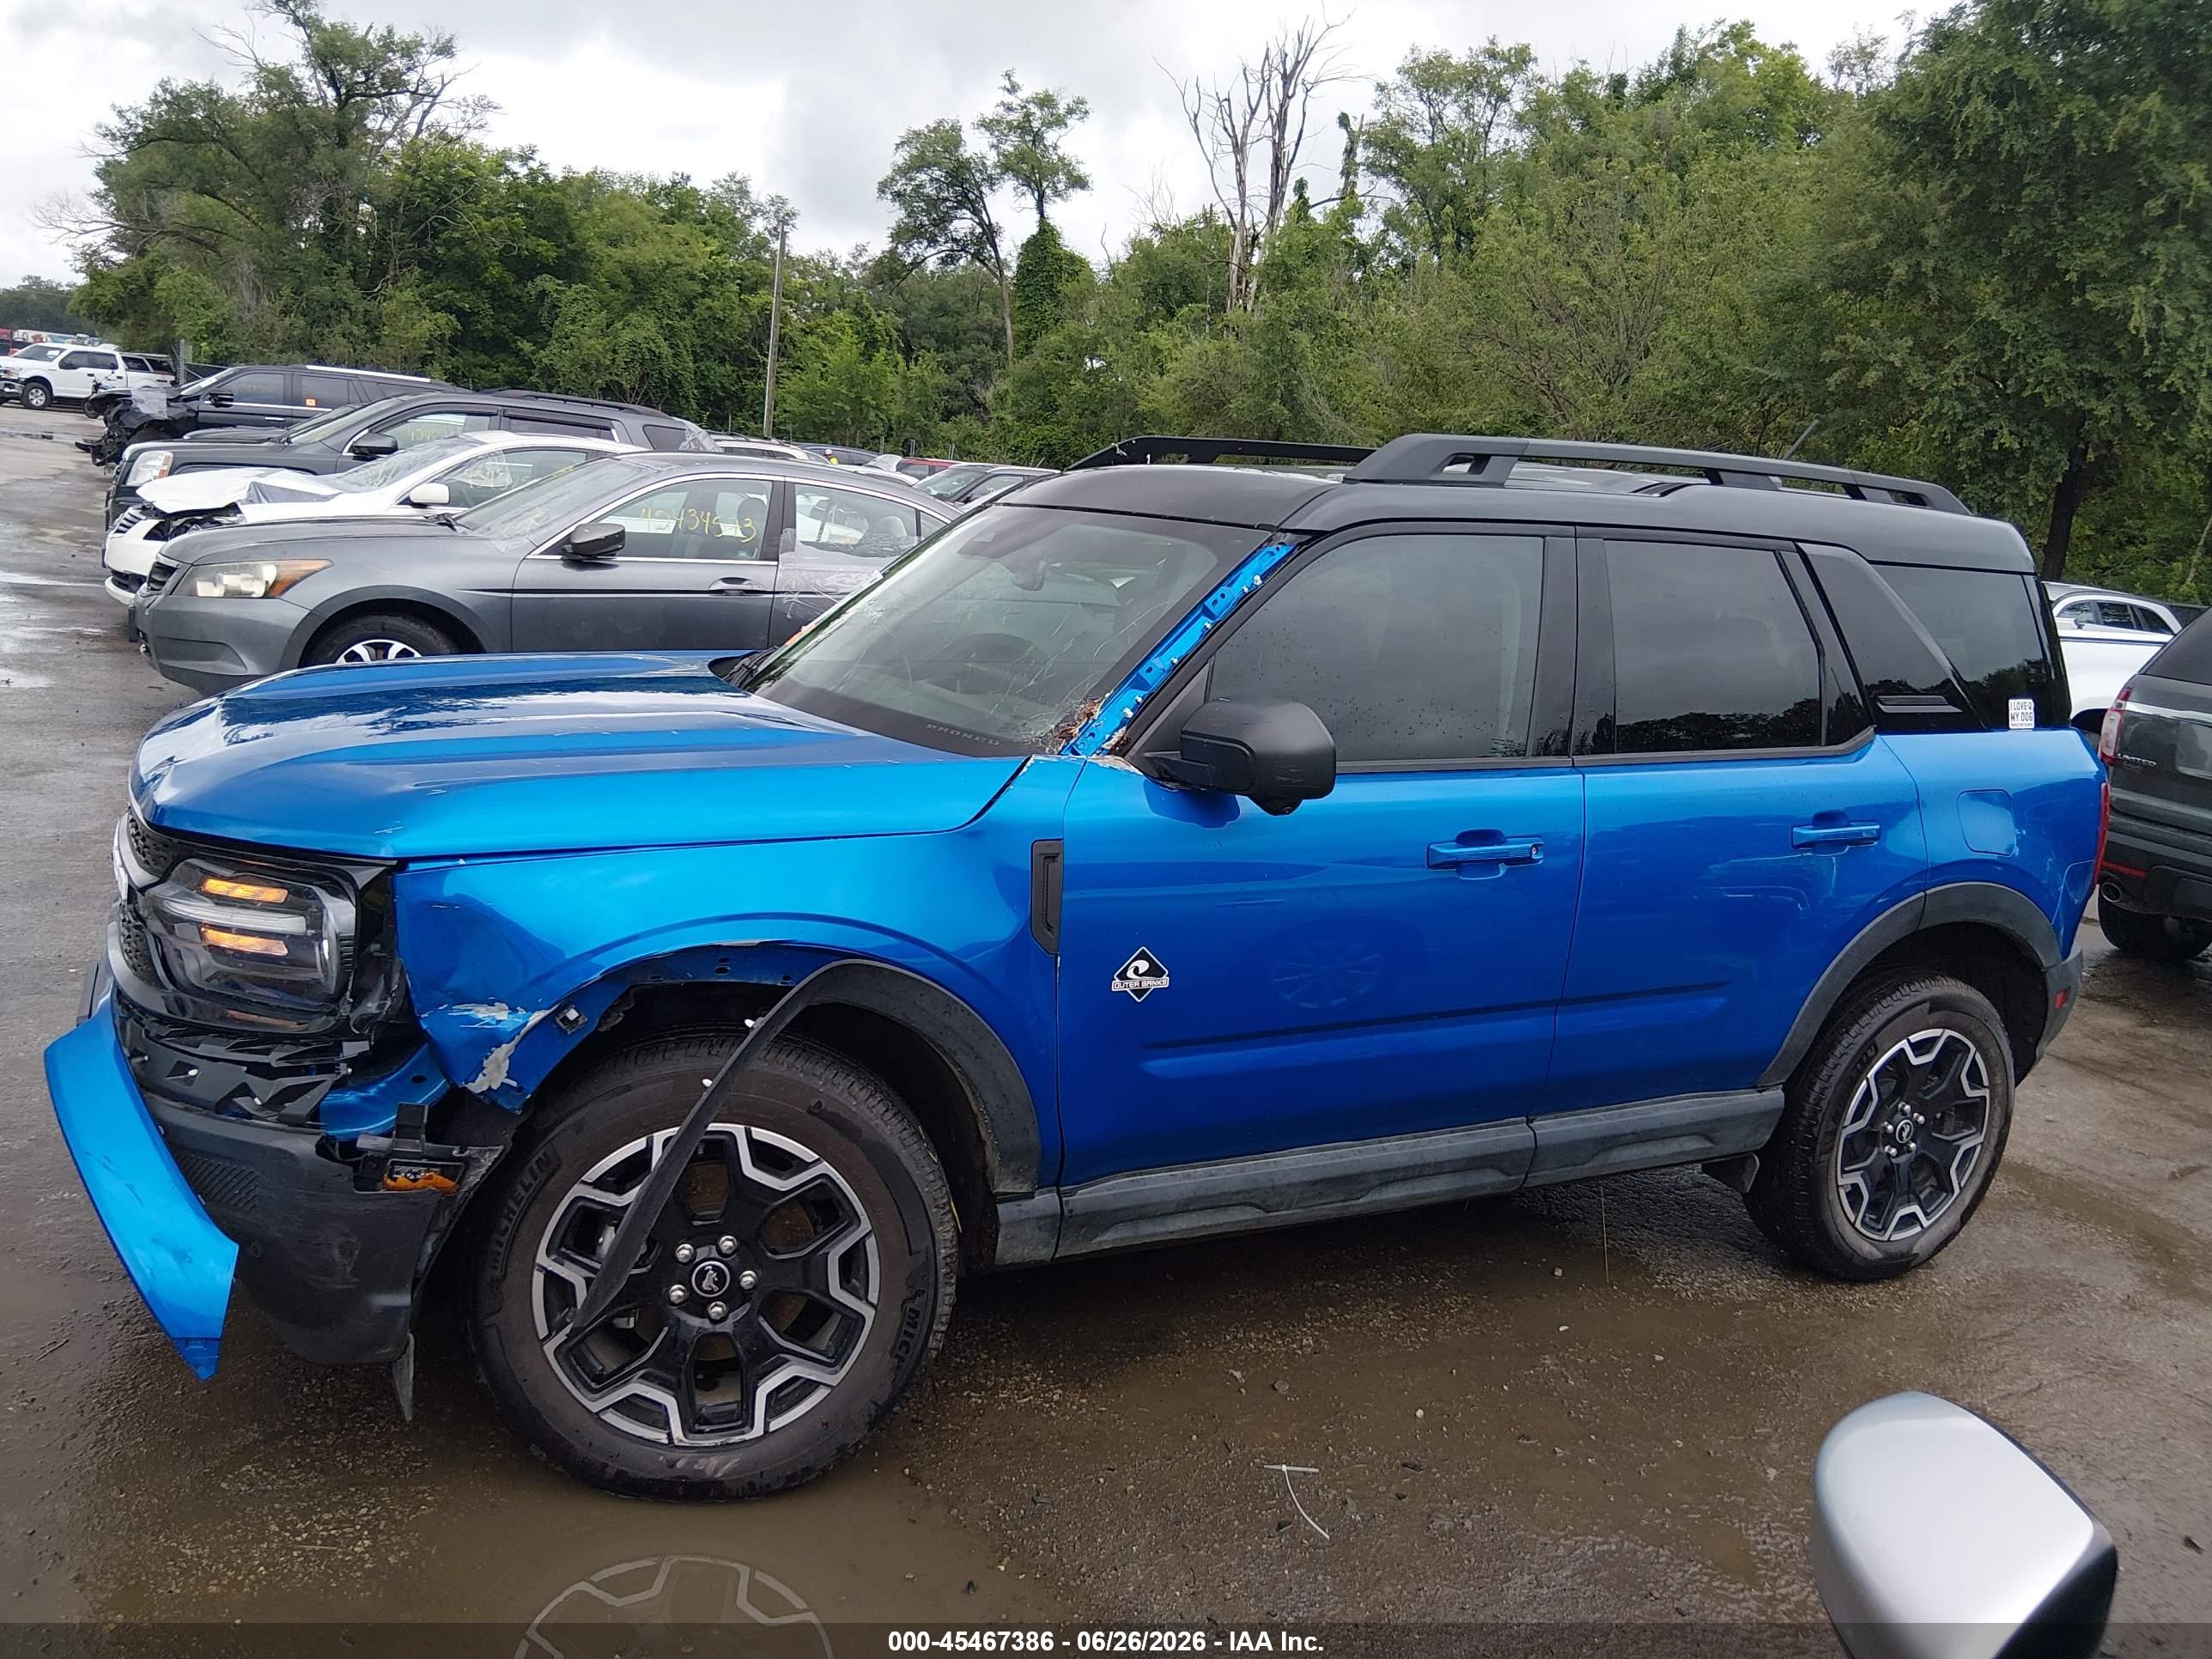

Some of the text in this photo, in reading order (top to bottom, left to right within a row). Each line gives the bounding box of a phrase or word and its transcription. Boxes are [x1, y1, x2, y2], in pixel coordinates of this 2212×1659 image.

[2014, 701, 2027, 711] LOVE
[2010, 712, 2033, 722] MY DOG
[926, 723, 1003, 748] BRONCO
[1114, 979, 1167, 989] OUTER BANKS
